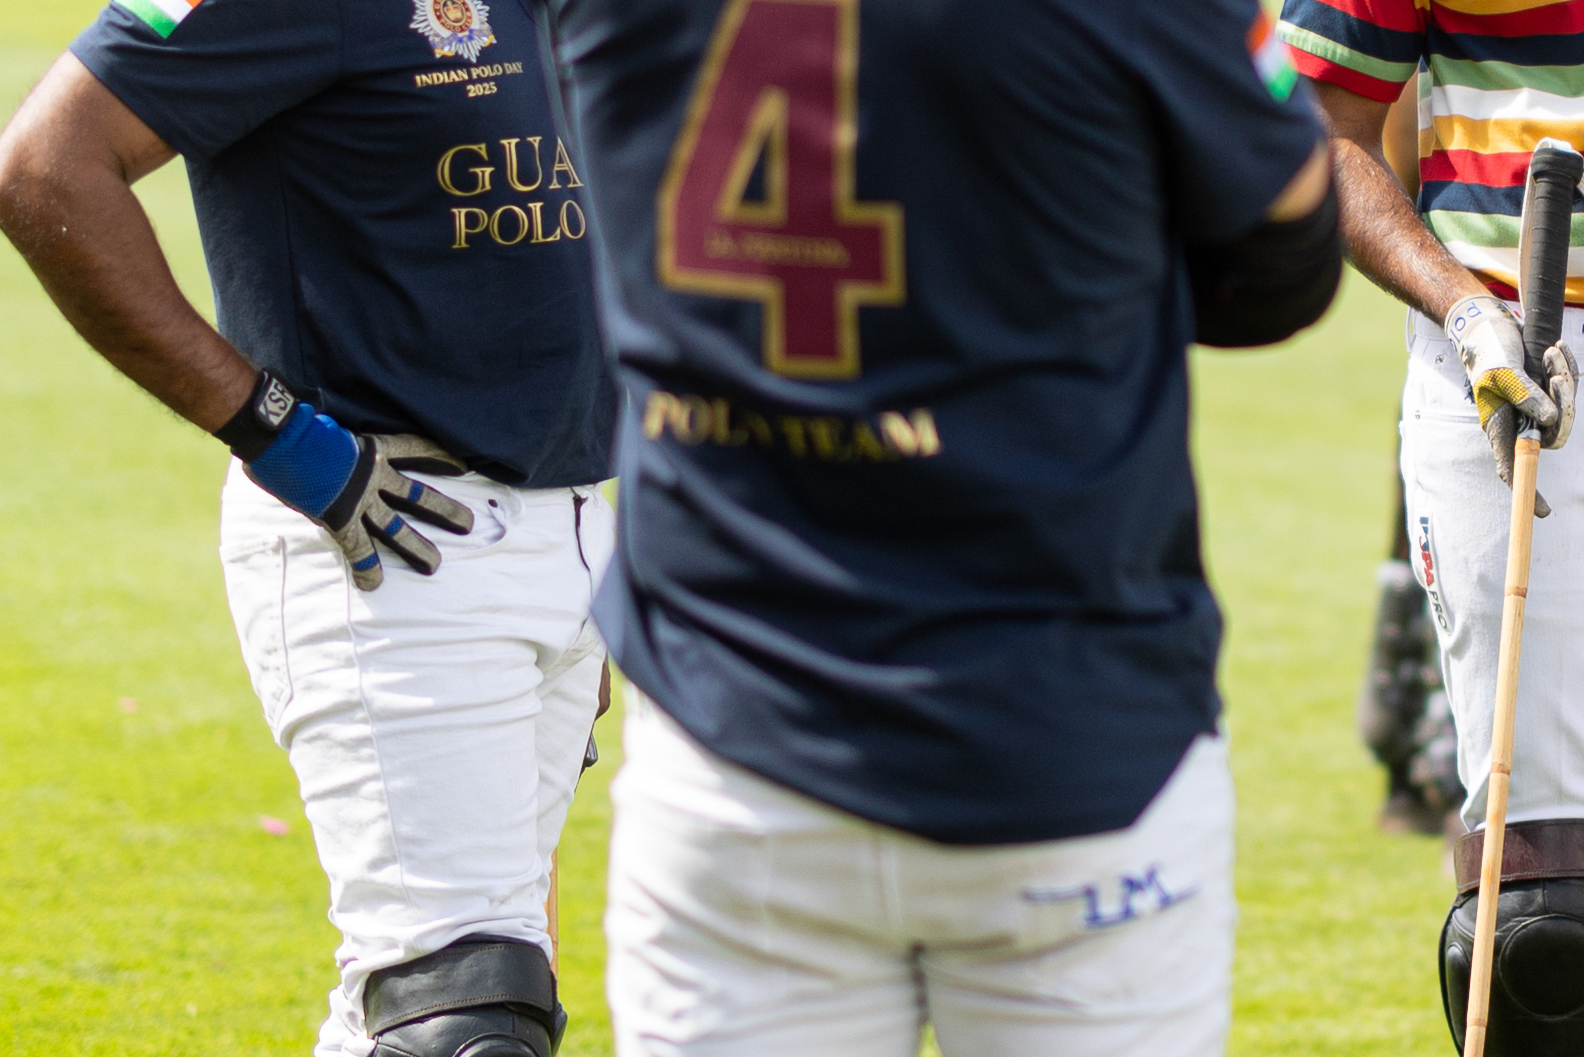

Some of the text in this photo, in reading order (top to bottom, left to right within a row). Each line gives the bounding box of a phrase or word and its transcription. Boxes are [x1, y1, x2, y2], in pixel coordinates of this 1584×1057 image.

[415, 61, 524, 88] INDIAN POLO DAY
[466, 82, 497, 97] 2025
[437, 136, 584, 196] GUA
[451, 199, 586, 249] POLO
[1428, 590, 1448, 630] PRO
